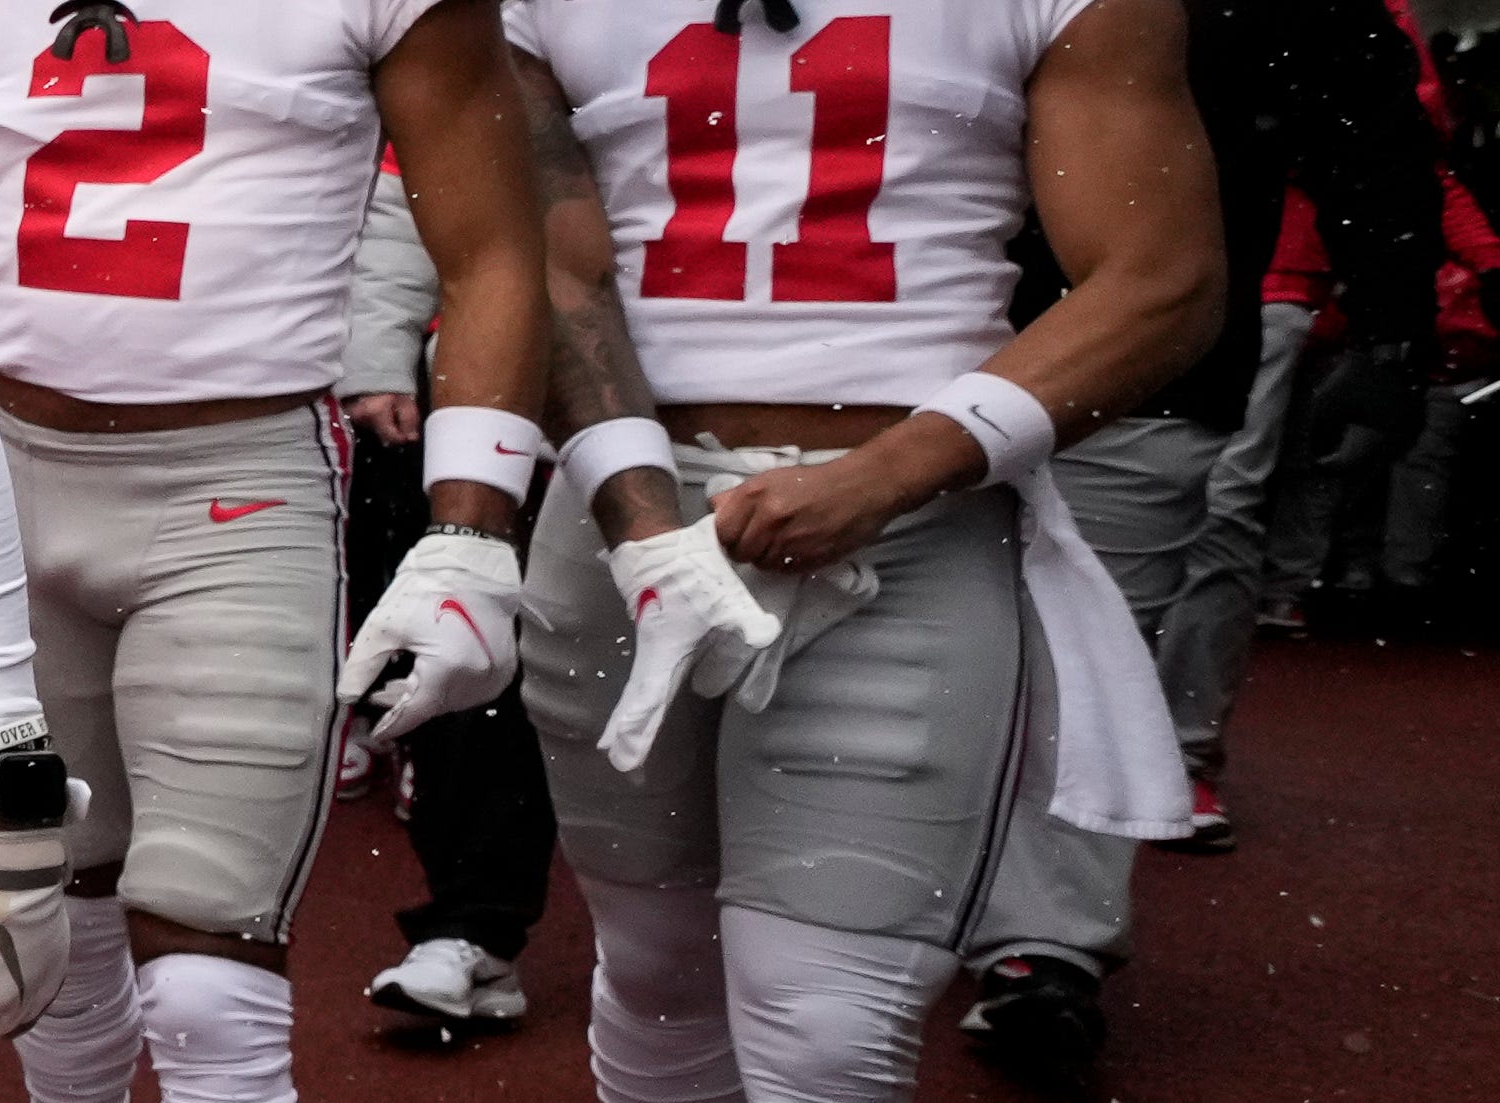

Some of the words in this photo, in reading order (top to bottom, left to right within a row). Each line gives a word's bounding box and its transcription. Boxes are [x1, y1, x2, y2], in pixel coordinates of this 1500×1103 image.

[17, 19, 211, 301] 2
[640, 15, 897, 302] 11
[0, 721, 37, 745] OVER
